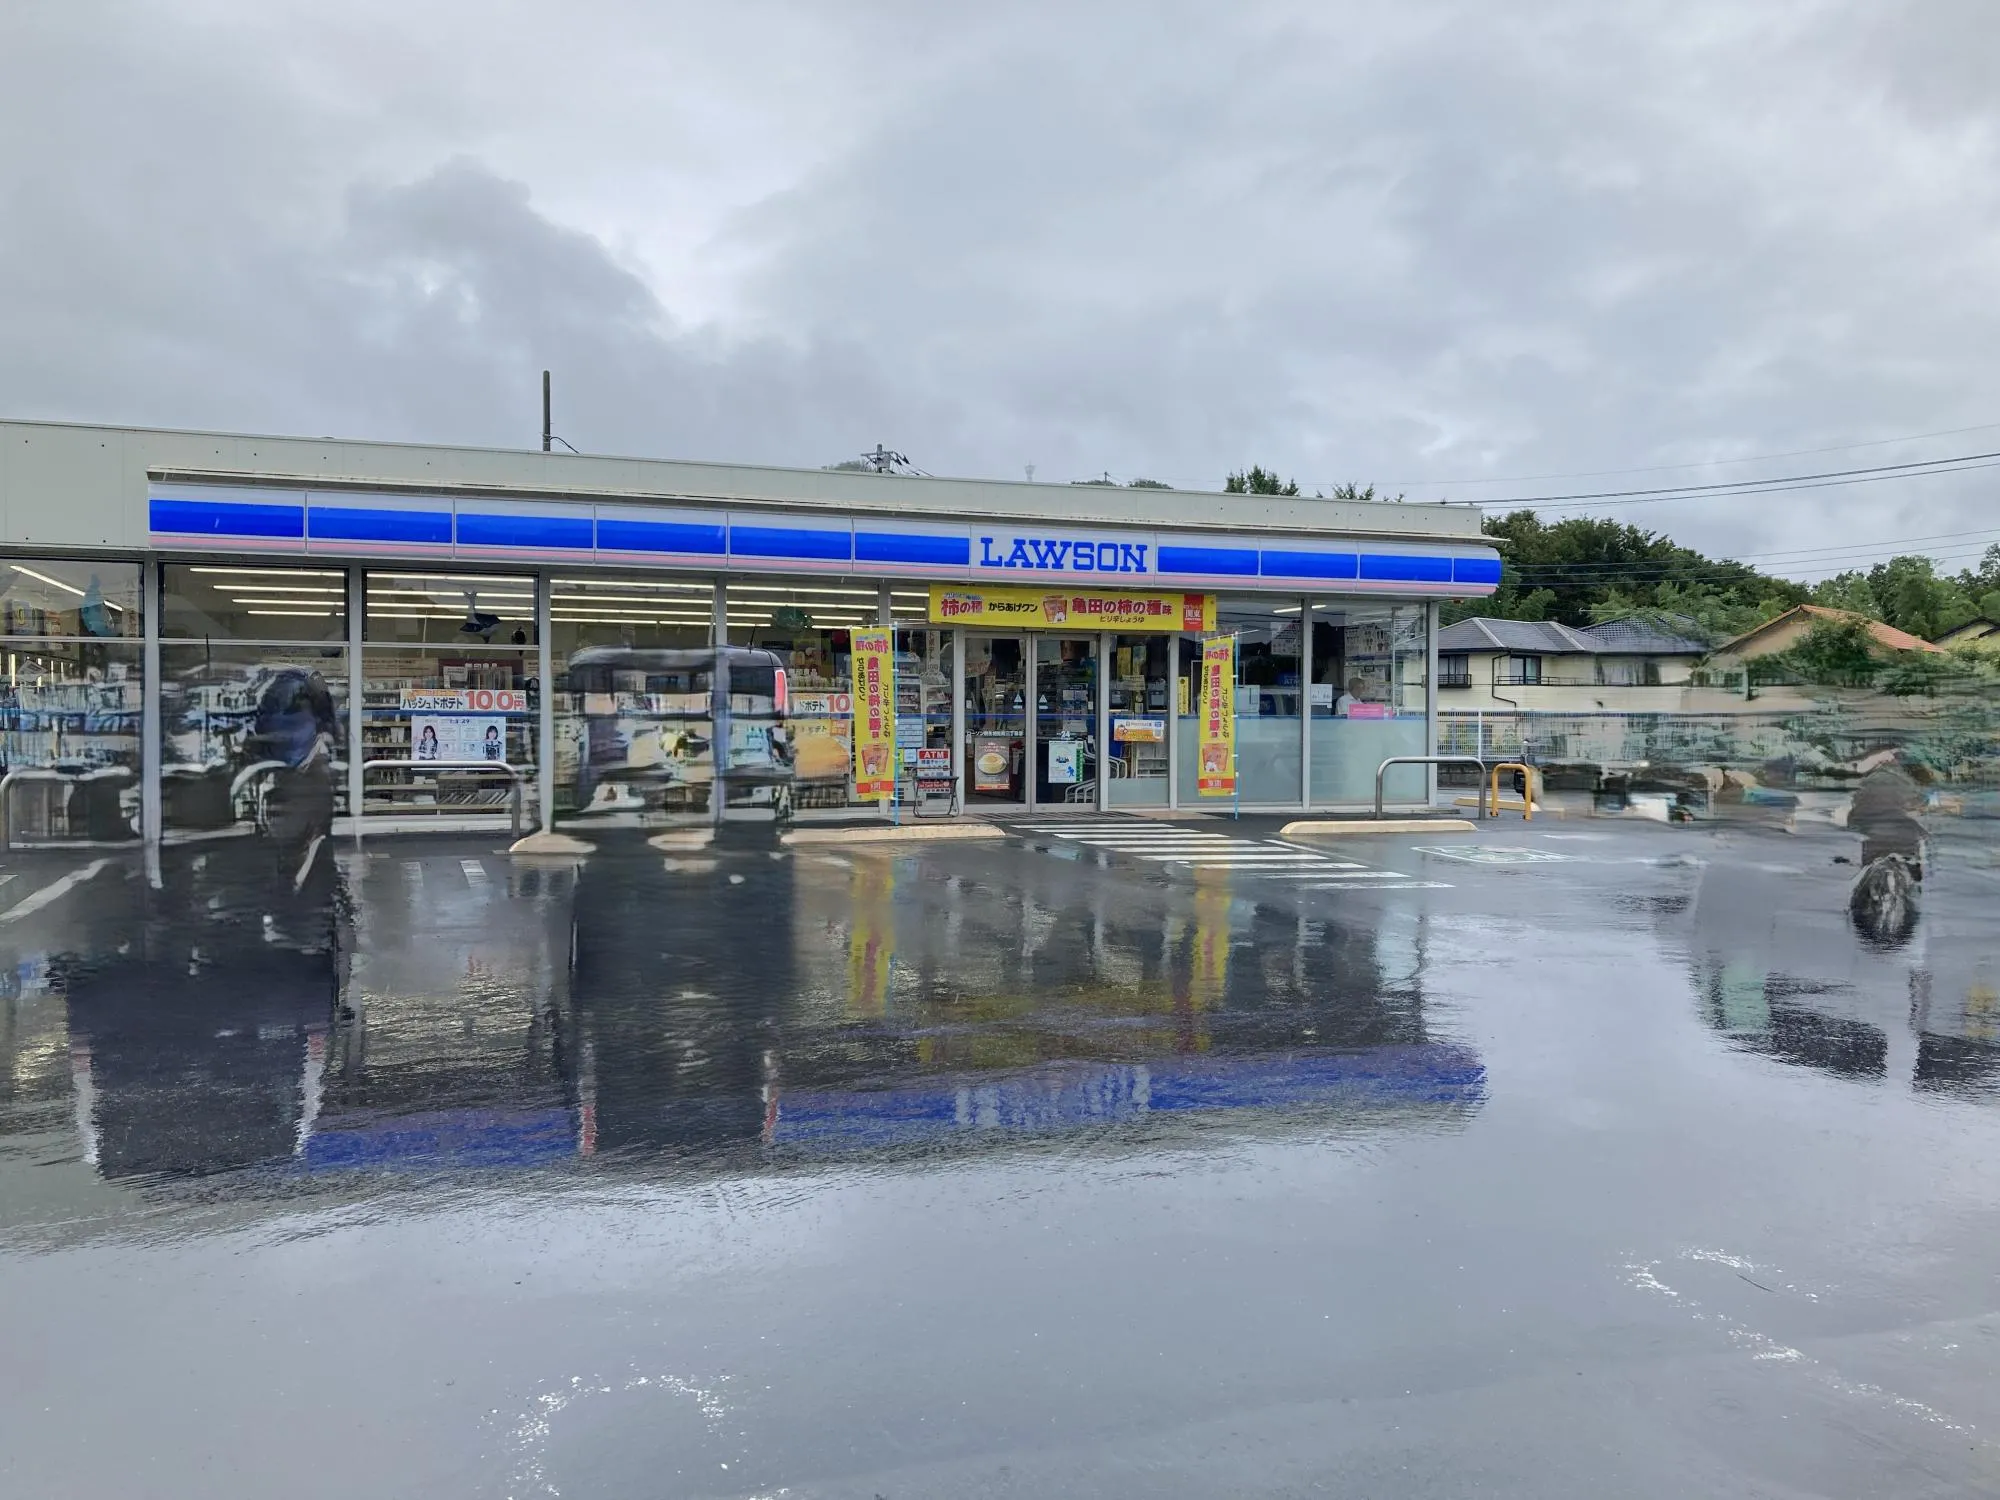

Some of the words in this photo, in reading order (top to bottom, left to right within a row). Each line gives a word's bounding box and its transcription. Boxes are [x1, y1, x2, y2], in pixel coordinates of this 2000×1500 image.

[980, 537, 1148, 572] LAWSON
[989, 602, 1038, 613] からあげクン
[1100, 615, 1145, 623] ピリ辛しょうゆ
[402, 697, 463, 709] ハッシュドポテト
